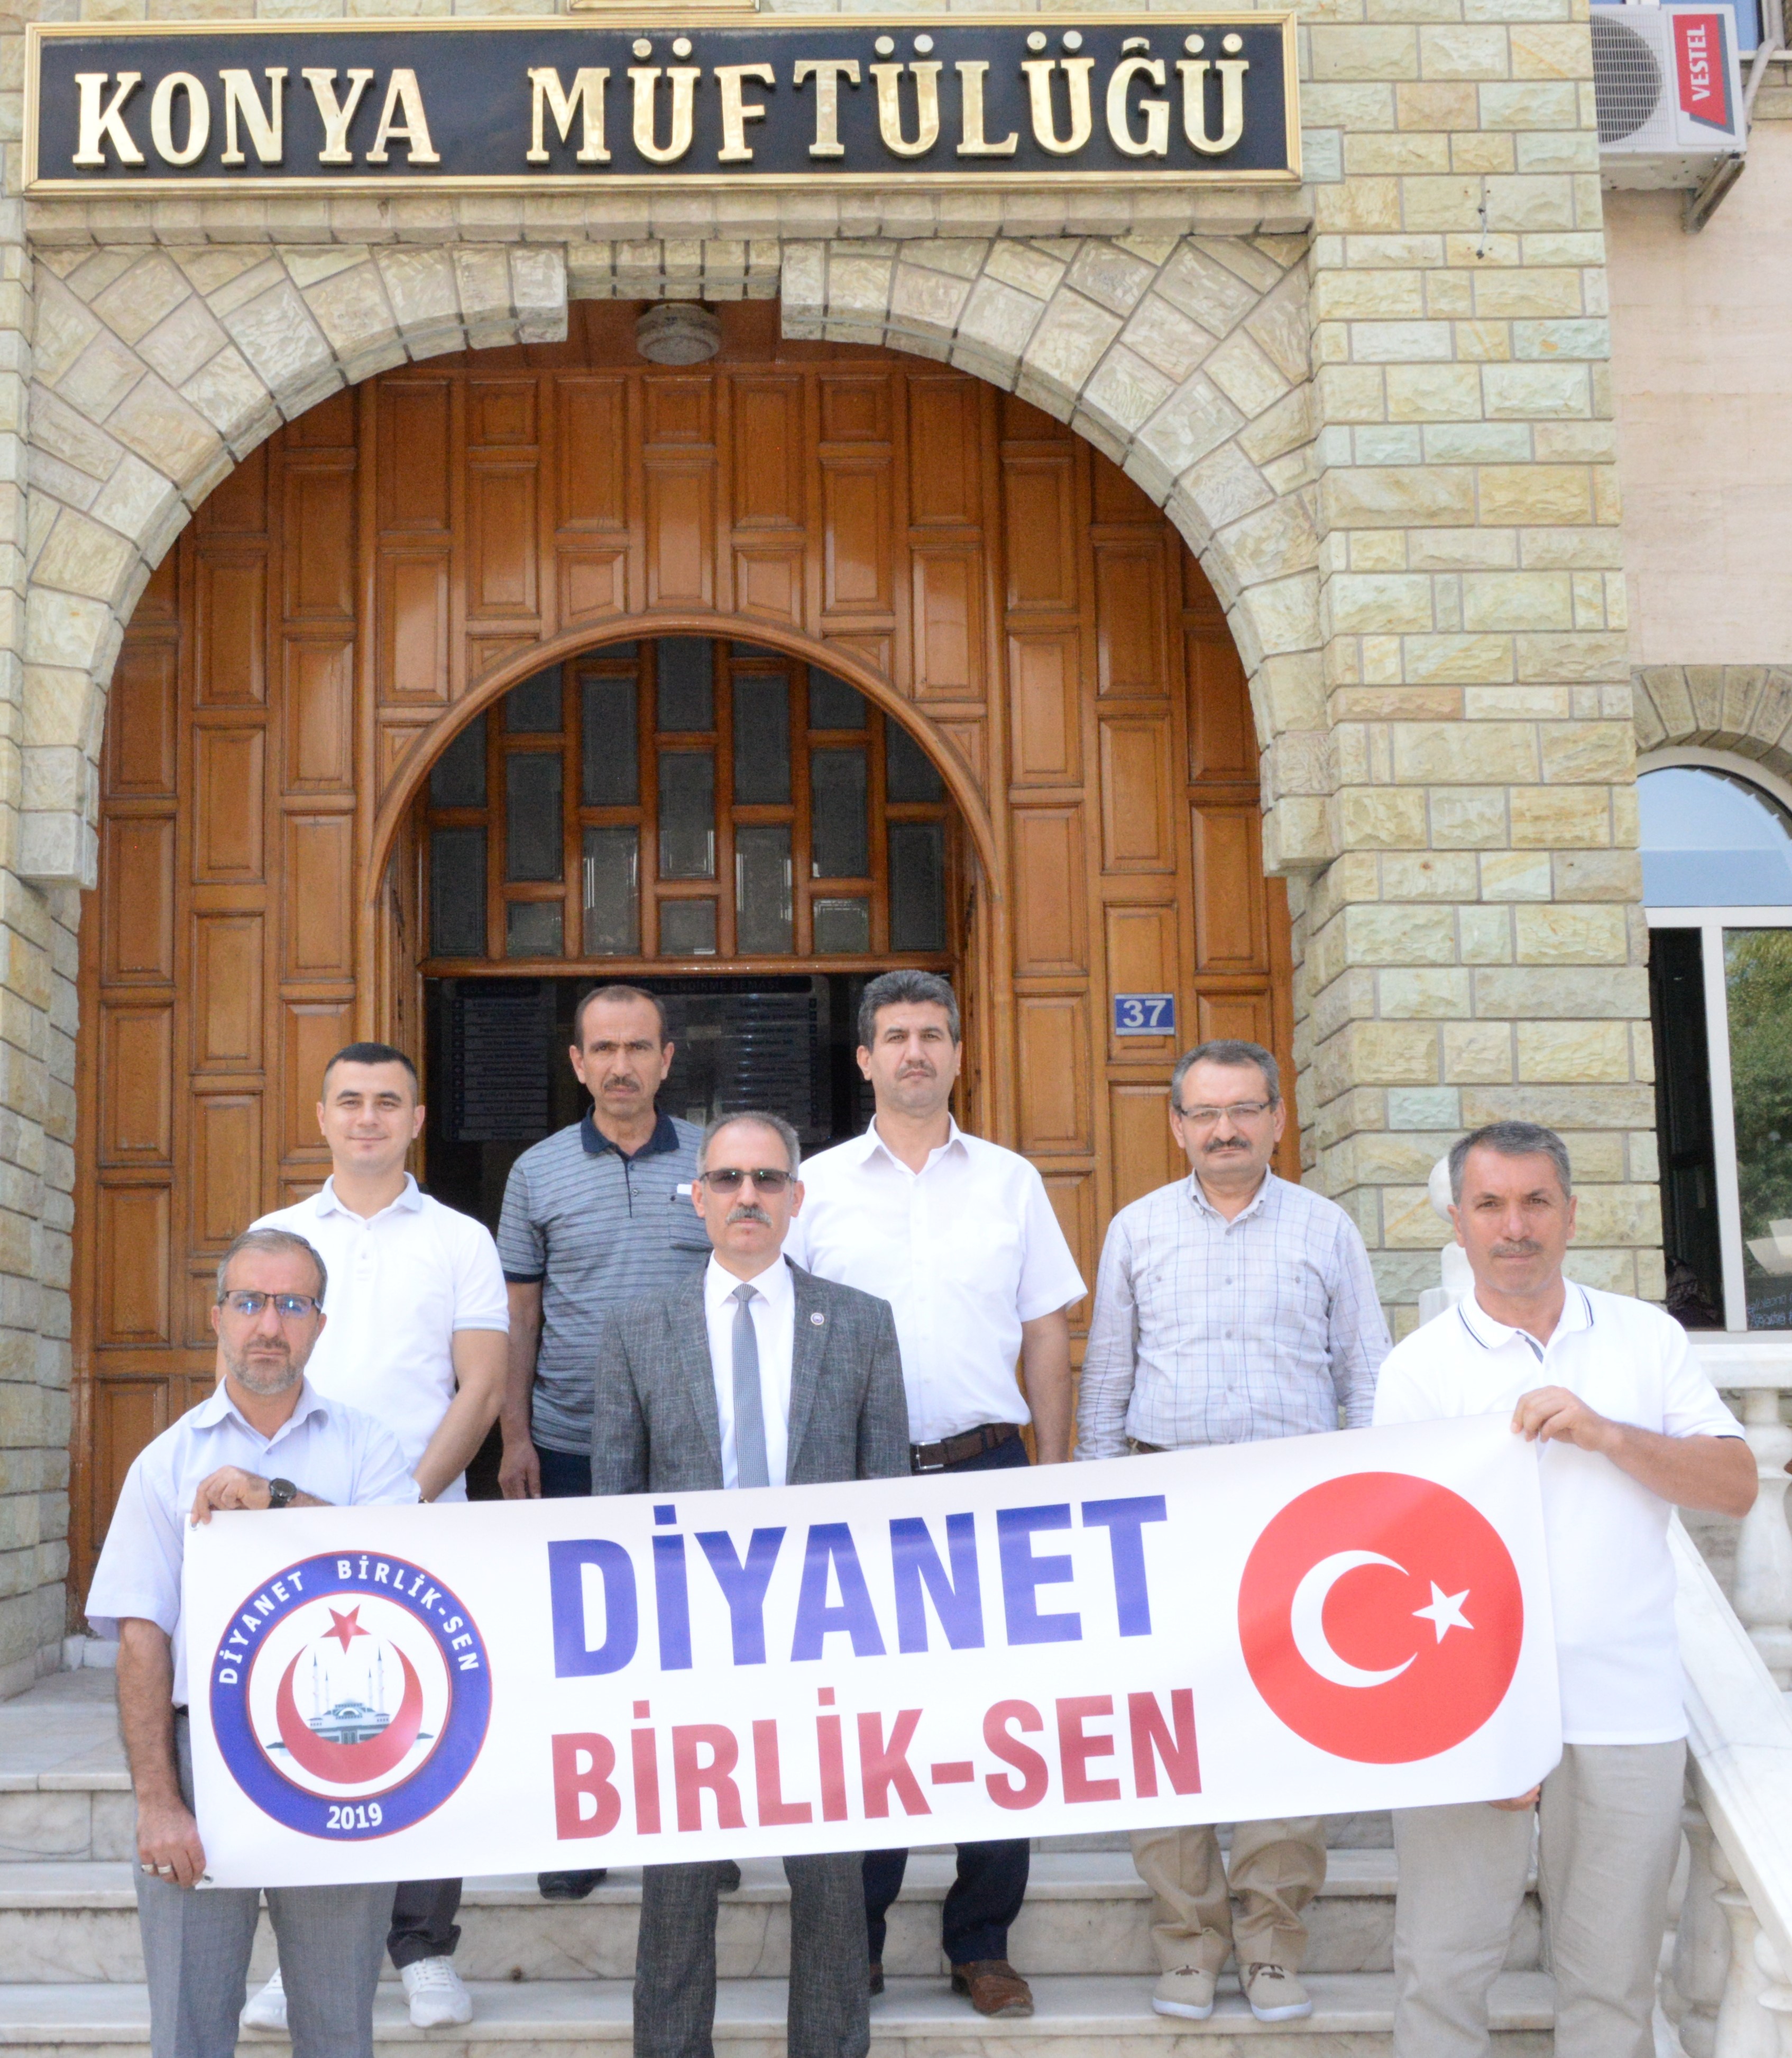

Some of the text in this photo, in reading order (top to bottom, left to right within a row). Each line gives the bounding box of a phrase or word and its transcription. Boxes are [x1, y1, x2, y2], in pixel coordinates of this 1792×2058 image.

[72, 31, 1249, 166] KONYA MÜFTÜLÜĞÜ
[1687, 24, 1711, 102] VESTEL
[1123, 1000, 1166, 1027] 37
[219, 1555, 479, 1685] DİYANET BİRLİK-SEN
[547, 1493, 1168, 1679] DİYANET
[326, 1803, 382, 1830] 2019
[551, 1686, 1202, 1841] BİRLİK-SEN
